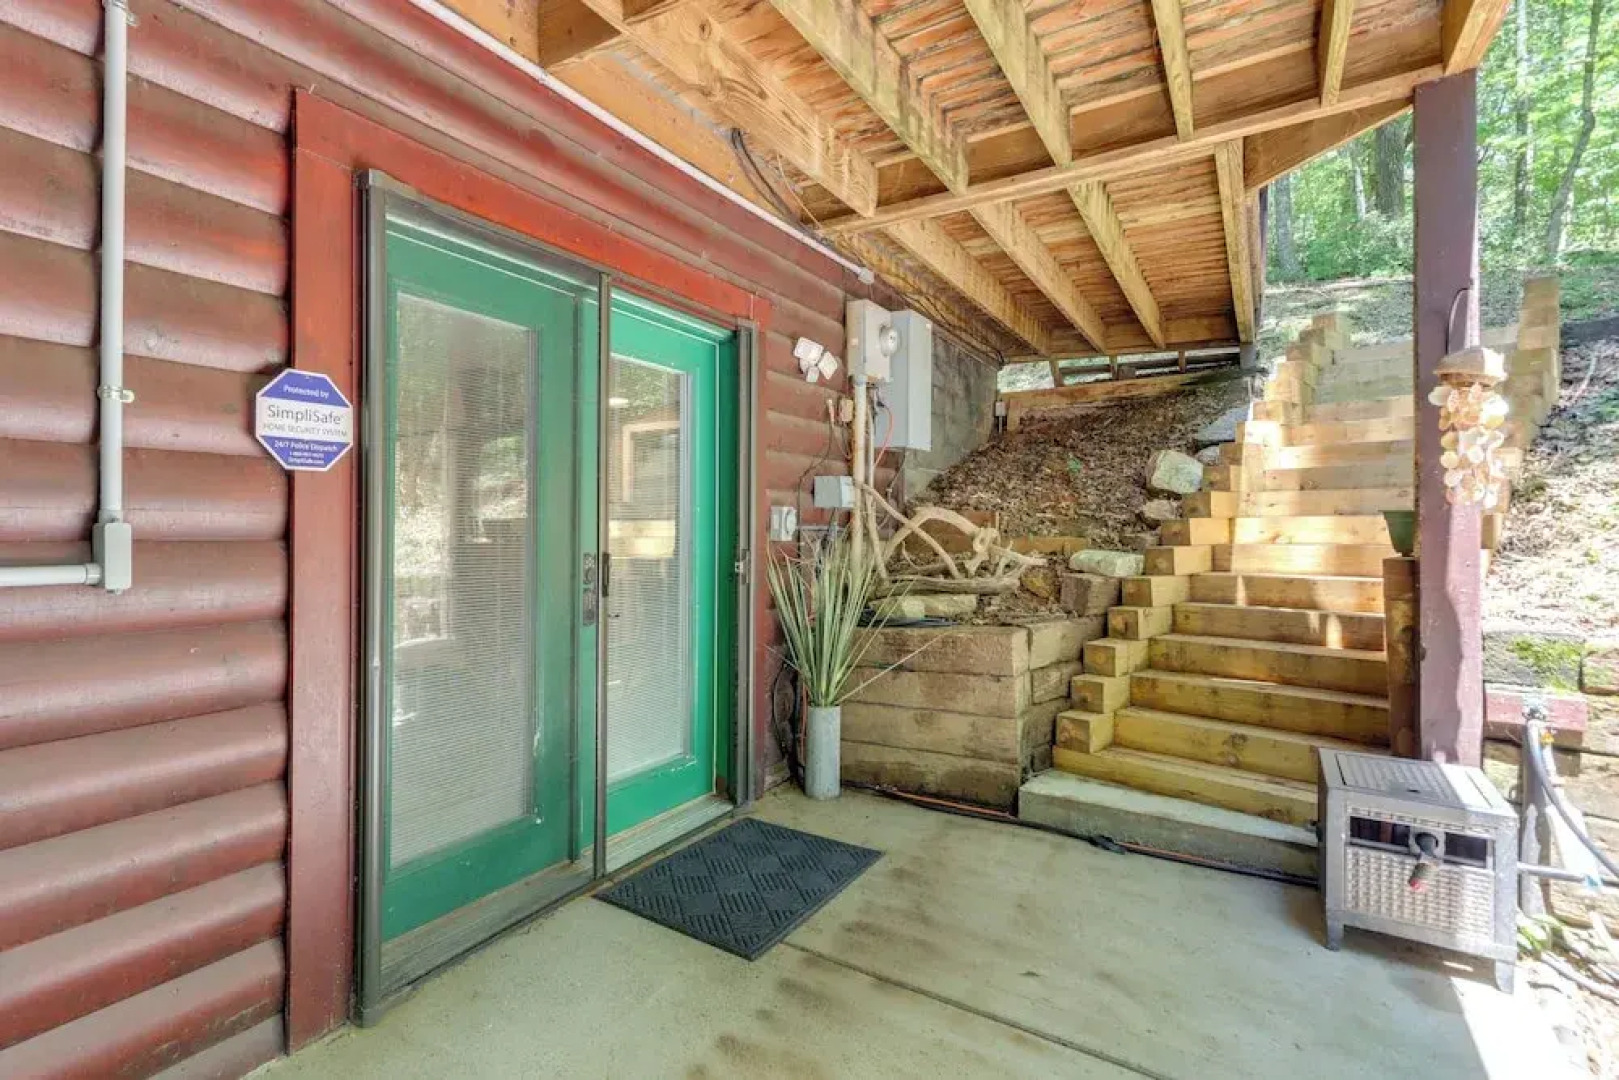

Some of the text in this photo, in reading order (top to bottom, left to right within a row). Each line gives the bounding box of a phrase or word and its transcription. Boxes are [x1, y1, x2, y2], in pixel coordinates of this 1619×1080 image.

[283, 384, 329, 399] Protected by
[268, 404, 341, 425] SimpliSafe
[263, 422, 286, 431] HOME
[288, 425, 319, 434] SECURITY
[274, 440, 337, 453] 24/7 Police Dispatch
